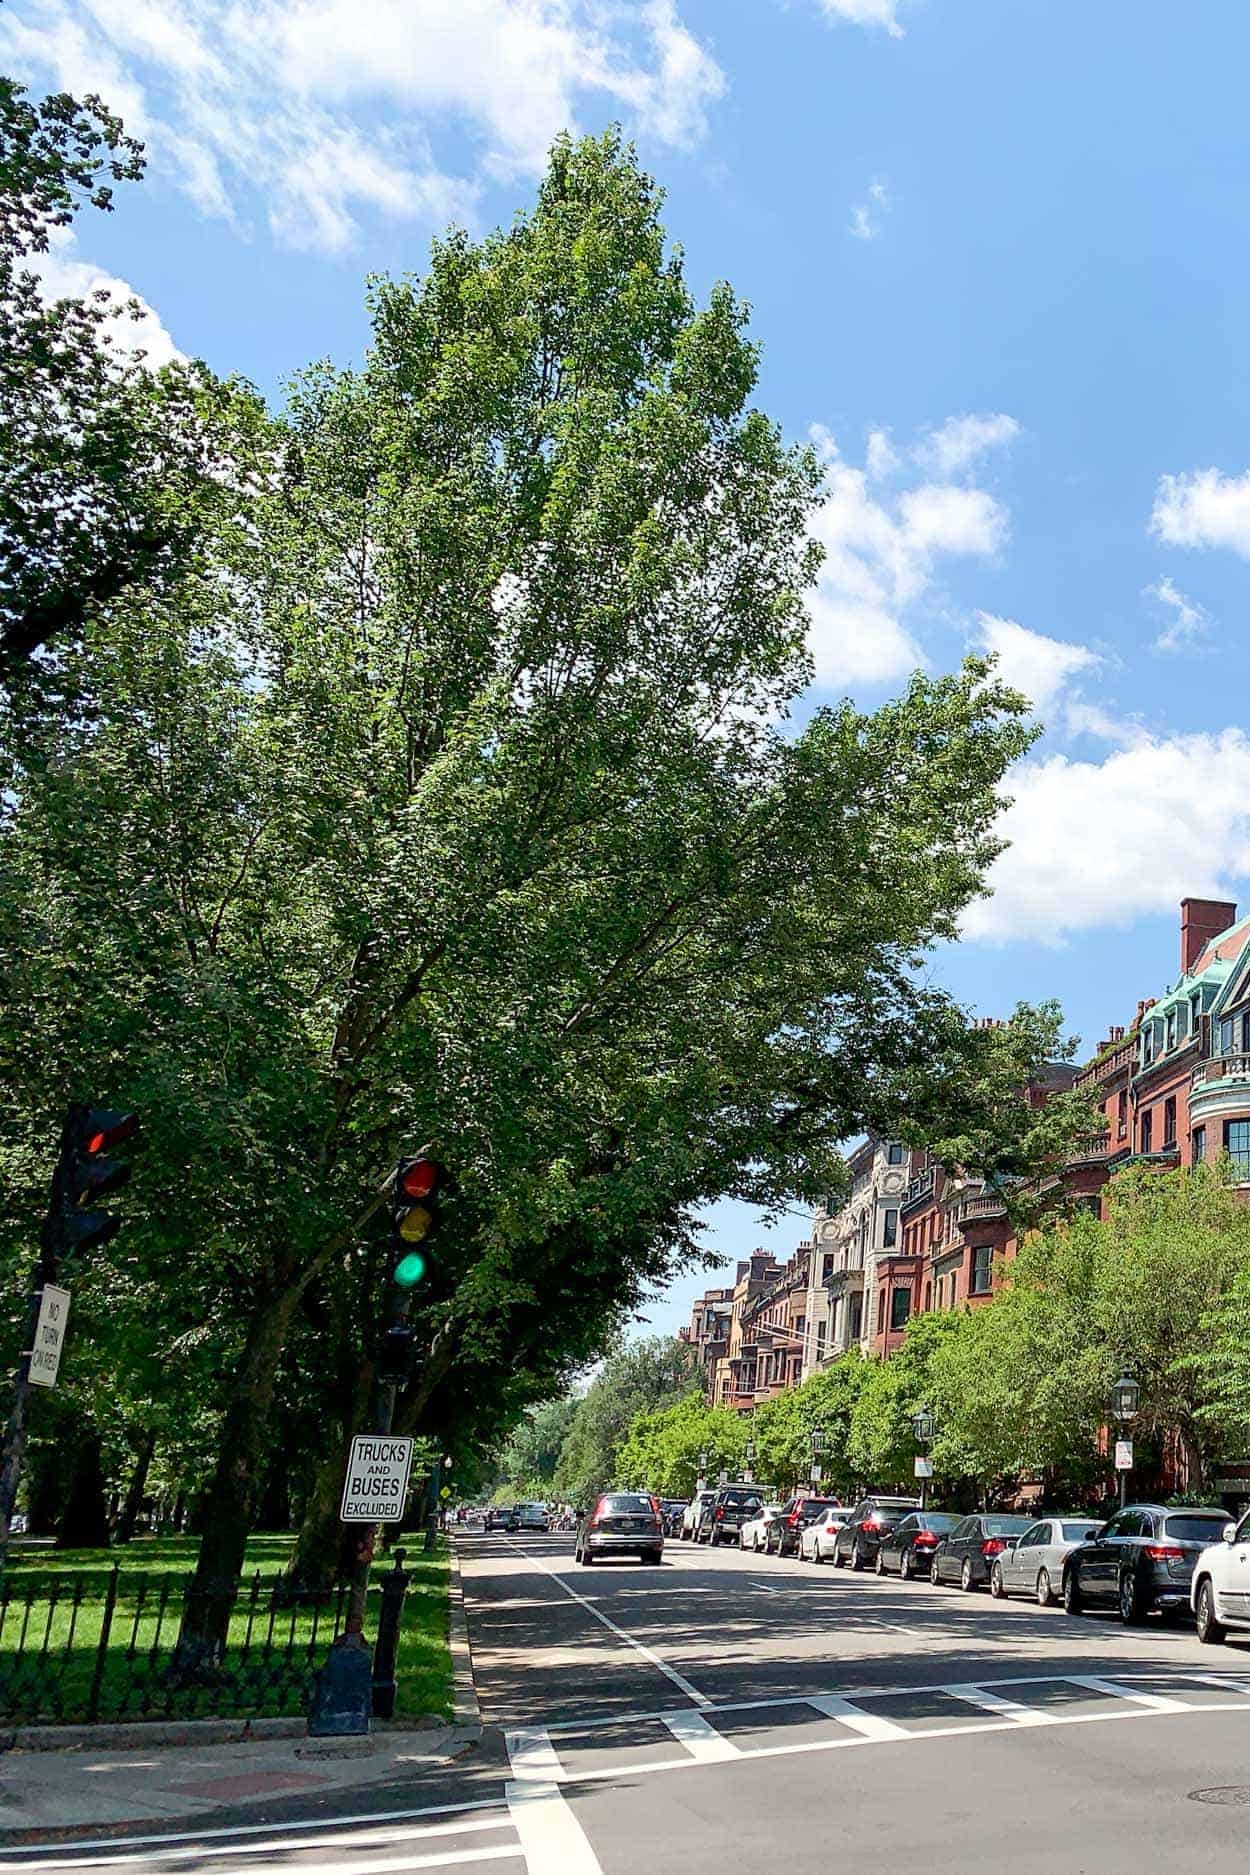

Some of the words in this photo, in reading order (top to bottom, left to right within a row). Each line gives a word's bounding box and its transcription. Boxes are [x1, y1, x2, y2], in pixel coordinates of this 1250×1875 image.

[358, 1443, 406, 1462] TRUCKS
[367, 1465, 390, 1474] AND
[351, 1477, 400, 1496] BUSES
[346, 1502, 398, 1515] EXCLUDED
